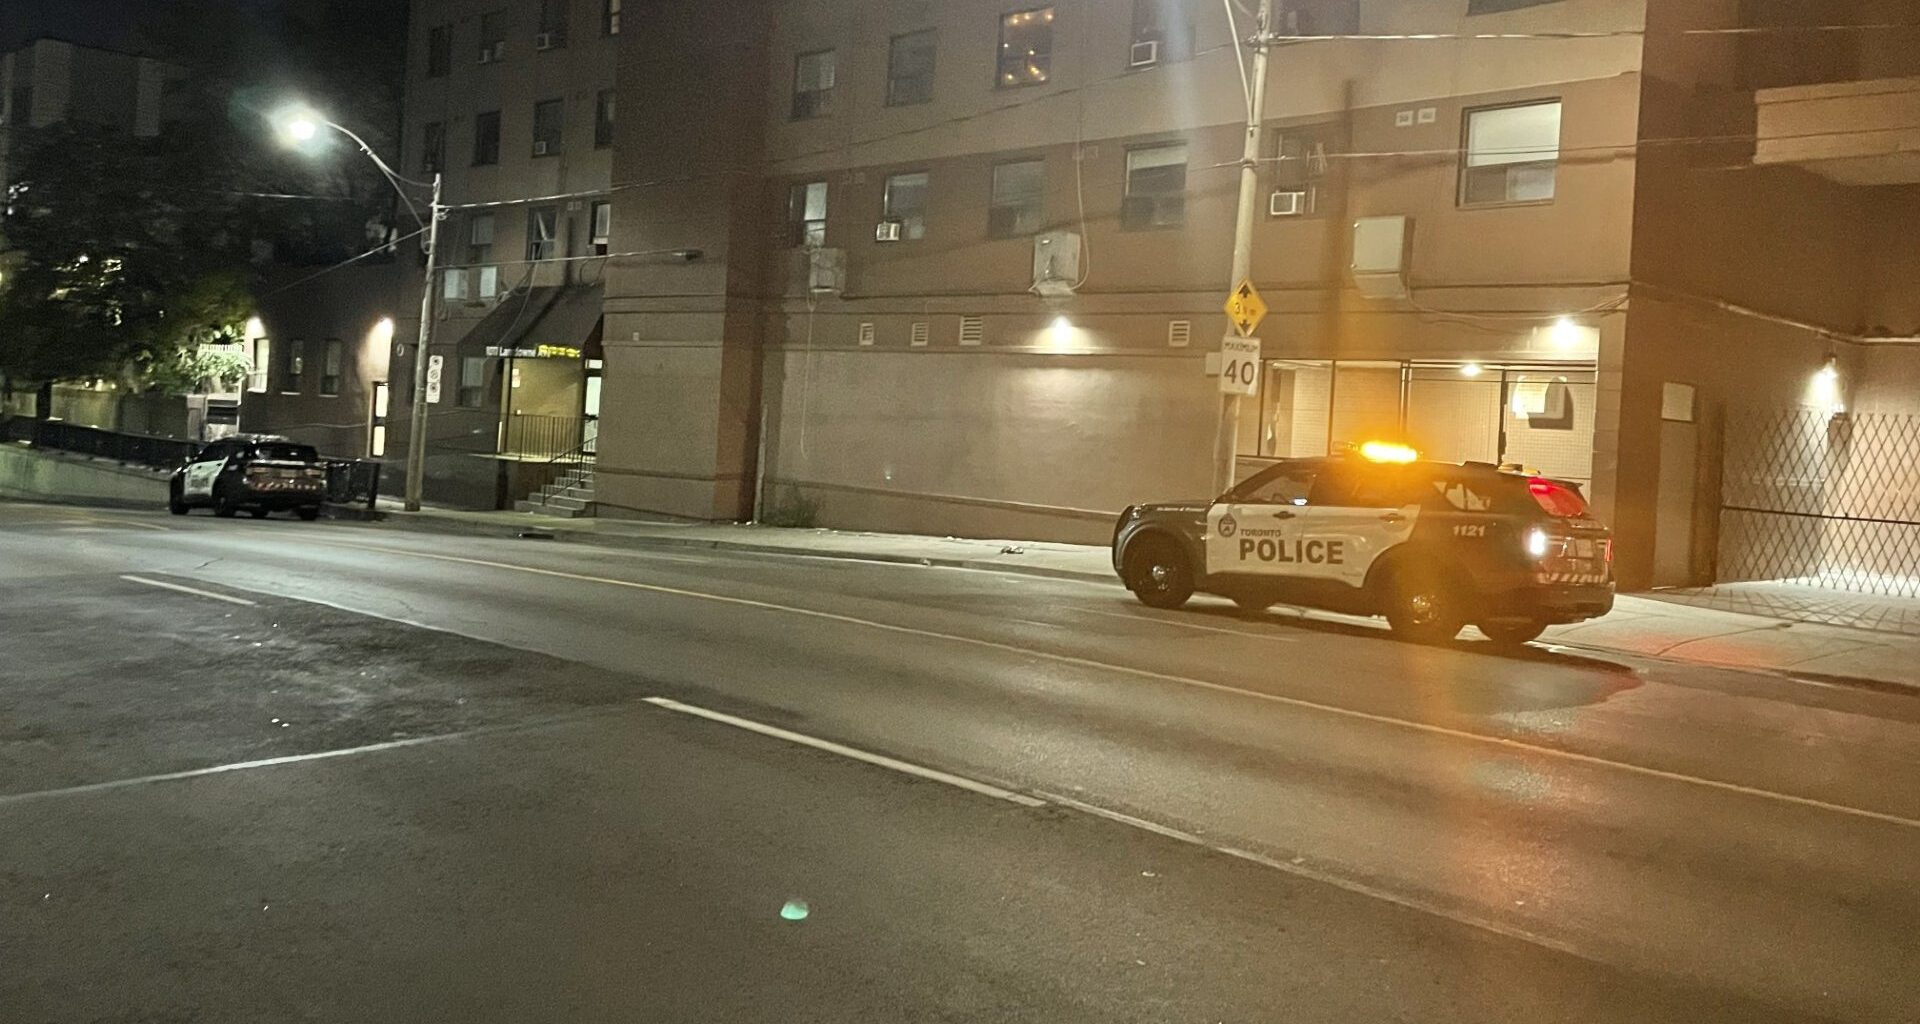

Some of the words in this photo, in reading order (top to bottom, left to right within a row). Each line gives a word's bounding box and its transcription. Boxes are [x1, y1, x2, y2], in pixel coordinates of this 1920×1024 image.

[1224, 360, 1254, 385] 40
[1240, 528, 1282, 538] TORONTO
[1453, 525, 1487, 537] 1121
[1239, 538, 1344, 565] POLICE
